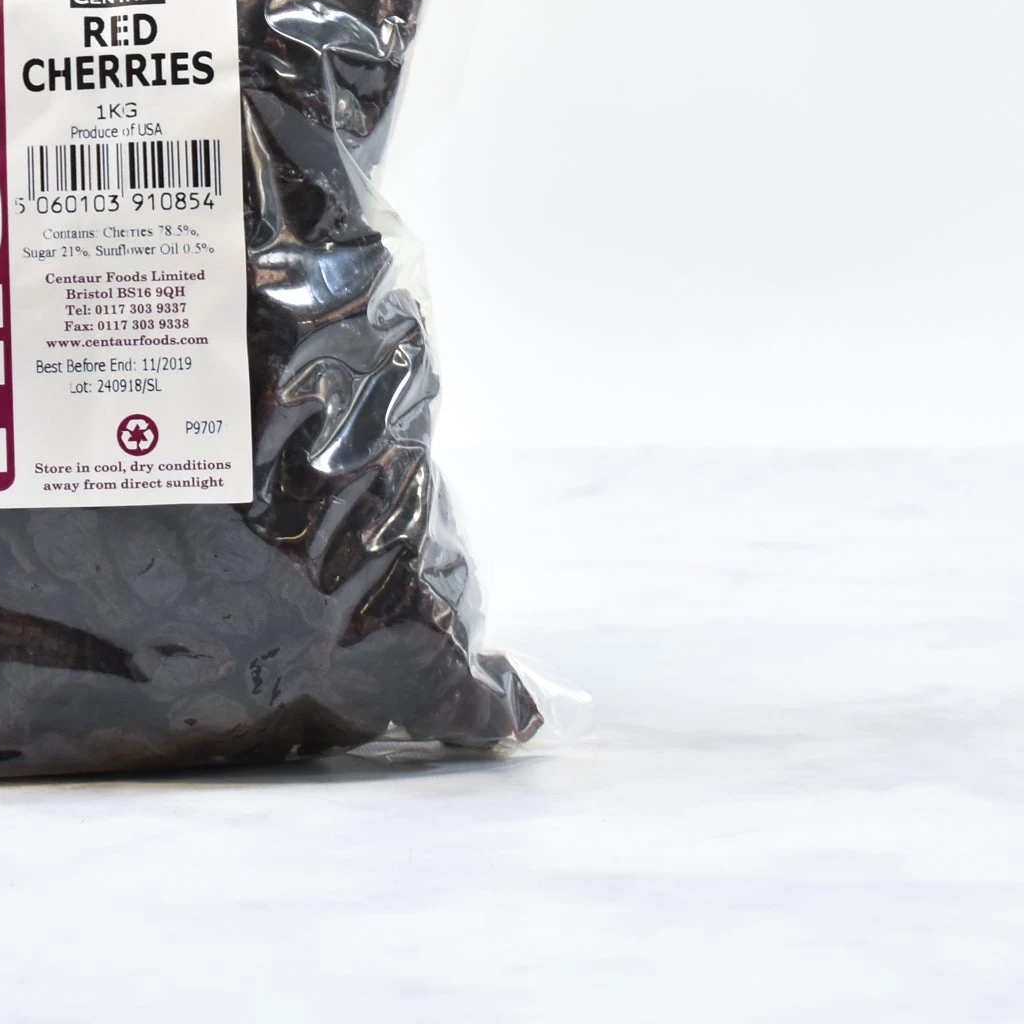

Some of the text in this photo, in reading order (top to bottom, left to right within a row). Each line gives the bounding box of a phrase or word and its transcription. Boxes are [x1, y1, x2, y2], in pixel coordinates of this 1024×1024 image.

[84, 13, 158, 47] RED
[22, 51, 214, 92] CHERRIES
[97, 102, 137, 119] 1KG
[71, 123, 162, 139] Produce of USA
[15, 193, 215, 214] 5 060103 910854
[23, 247, 56, 261] Sugar
[96, 244, 156, 256] Sunflower
[161, 243, 178, 254] Oil
[183, 243, 215, 254] 0.5%
[45, 270, 205, 284] Centaur Foods Limited
[66, 286, 186, 299] Bristol BS16 9QH
[65, 303, 187, 315] Tel: 0117 303 9337
[64, 319, 189, 332] Fax: 0117 303 9338
[46, 335, 209, 348] www.centaurfoods.com
[36, 356, 192, 373] Best Before End: 11/2019
[70, 378, 162, 394] Lot: 240918/SL
[186, 420, 223, 434] P9707
[35, 460, 231, 474] Store in cool, dry conditions
[44, 477, 224, 492] away from direct sunlight
